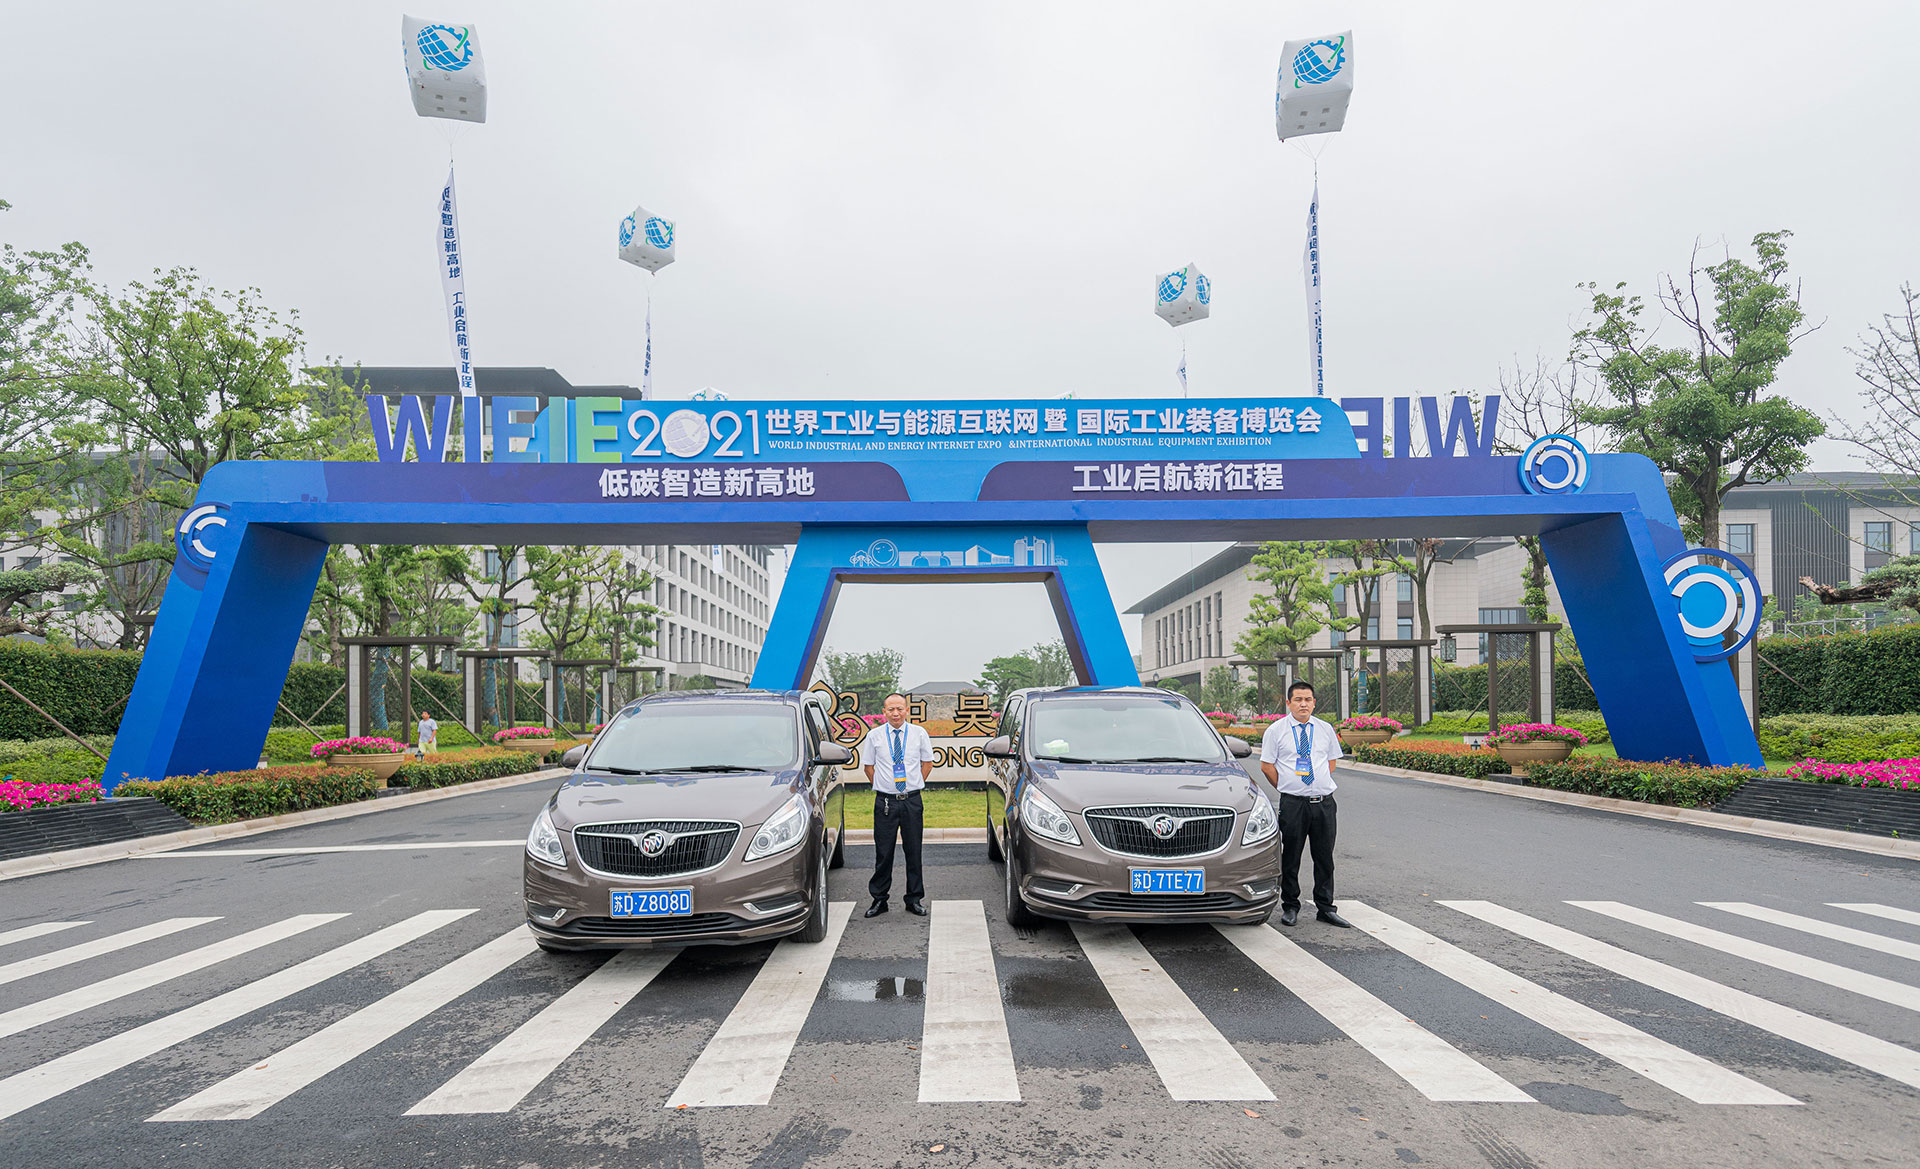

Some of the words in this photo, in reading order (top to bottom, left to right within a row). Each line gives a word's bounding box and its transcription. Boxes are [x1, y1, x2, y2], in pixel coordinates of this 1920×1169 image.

[366, 395, 623, 463] WIEIE
[765, 408, 1038, 436] 世界工业与能源互联网
[1044, 408, 1067, 434] 暨
[1077, 406, 1323, 435] 国际工业装备博览会
[768, 440, 803, 450] WORLD
[806, 441, 863, 451] INDUSTRIAL
[865, 441, 885, 451] AND
[887, 441, 925, 451] ENERGY
[927, 440, 976, 450] INTERNET
[977, 440, 1002, 449] EXPO
[1008, 438, 1092, 449] &INTERNATIONAL
[1096, 437, 1154, 447] INDUSTRIAL
[1158, 437, 1215, 447] EQUIPMENT
[1216, 436, 1272, 446] EXHIBITION
[599, 467, 816, 498] 低碳智造新高地
[1072, 463, 1285, 492] 工业启航新征程
